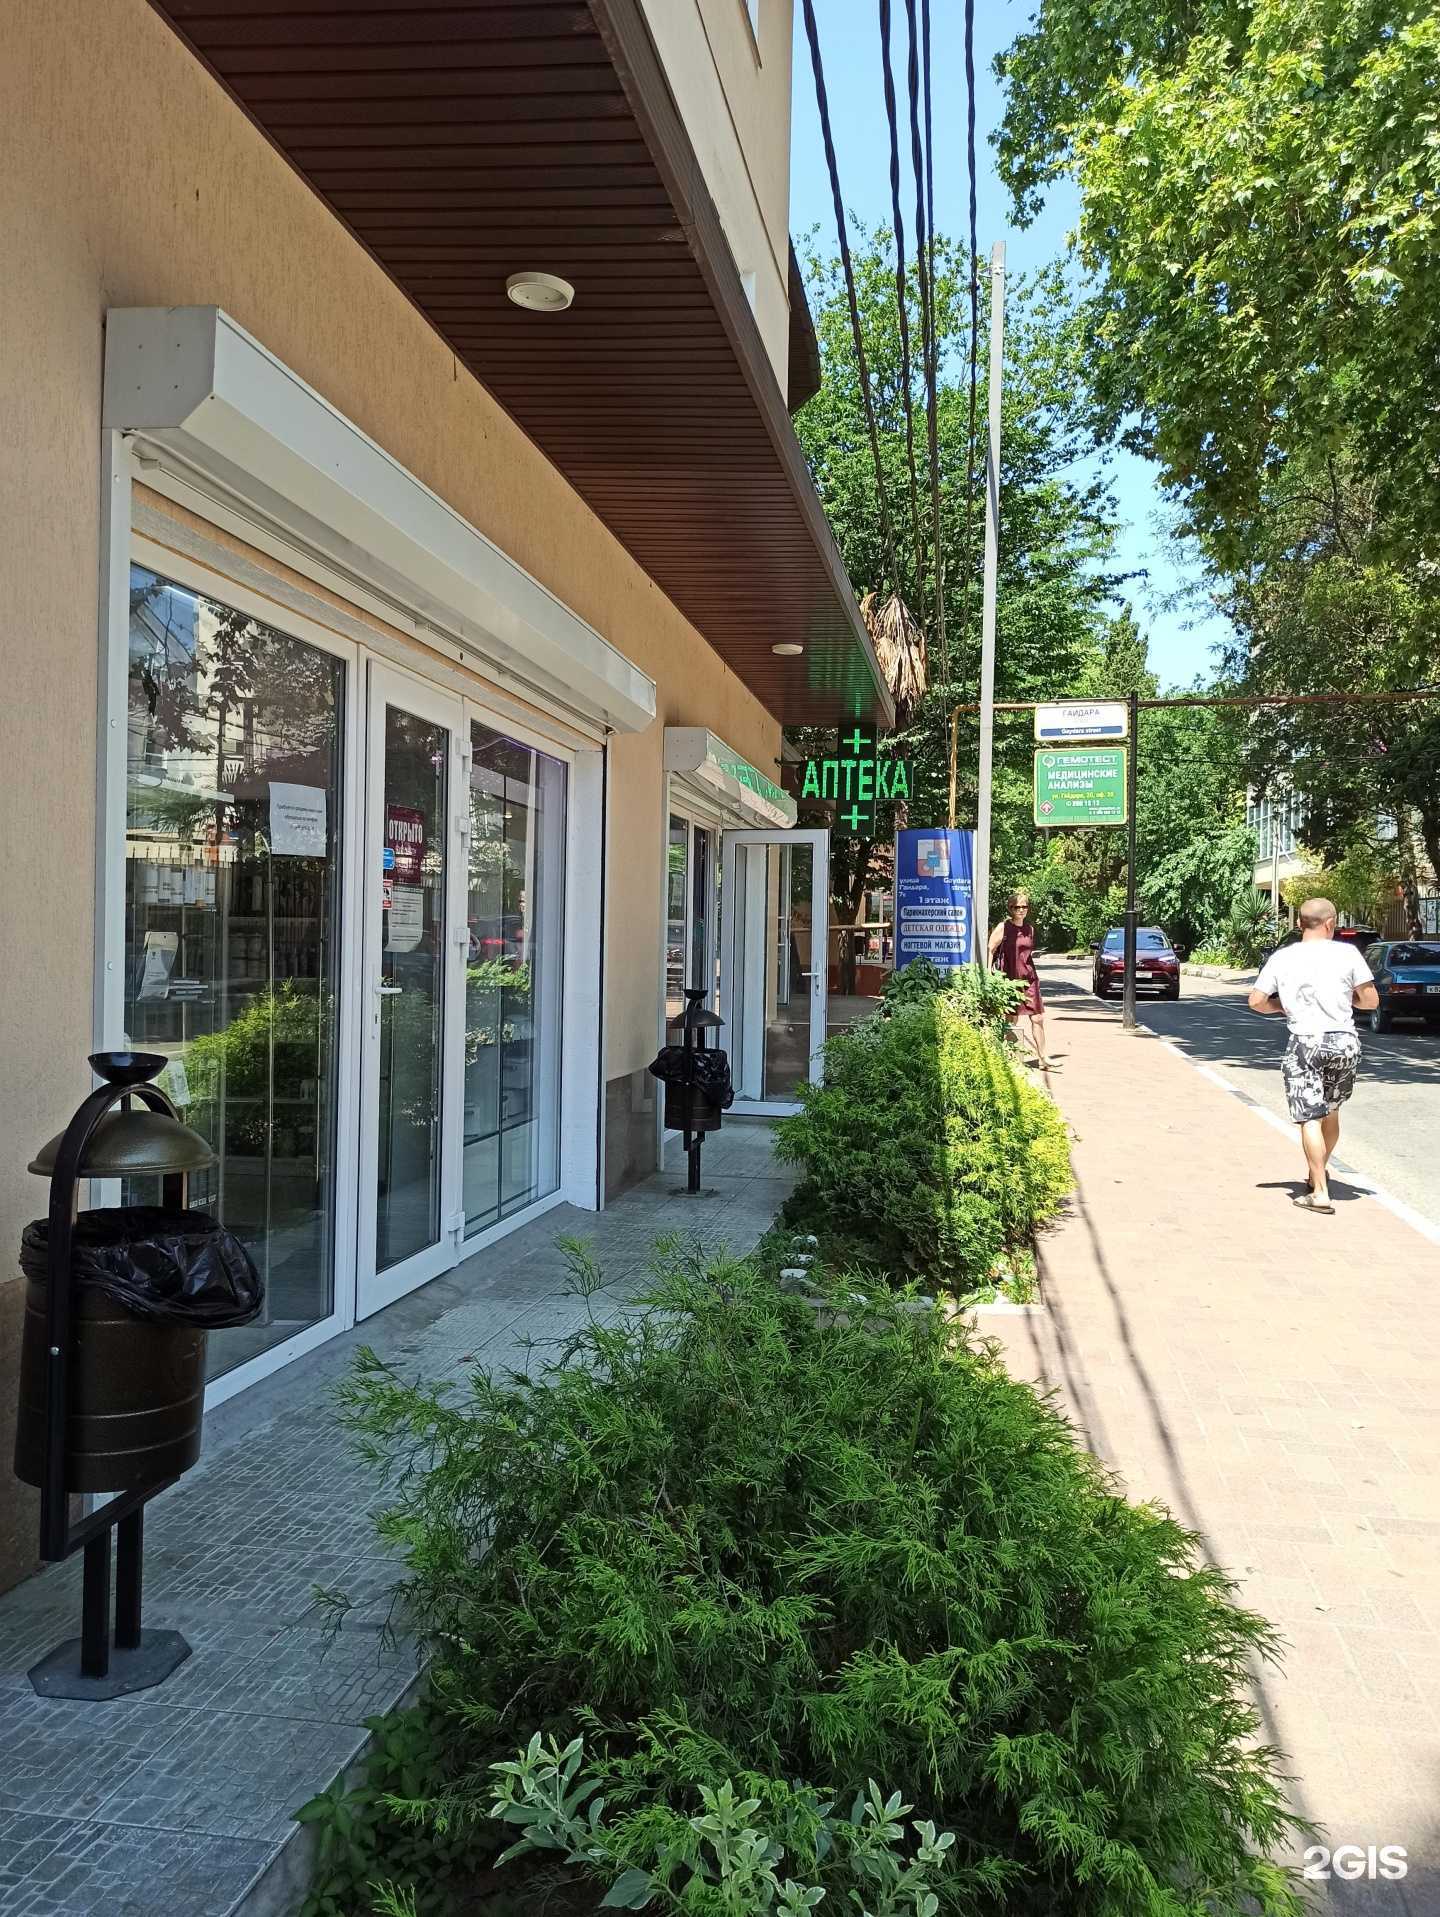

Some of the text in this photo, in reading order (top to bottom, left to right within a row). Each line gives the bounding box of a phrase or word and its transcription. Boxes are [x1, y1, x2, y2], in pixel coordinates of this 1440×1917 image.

[1047, 769, 1118, 780] МЕДИЦИНСКИЕ
[801, 760, 909, 800] АПТЕКА
[1047, 780, 1094, 790] АНАЛИЗЫ
[388, 819, 423, 844] ОТКРЫТО
[903, 924, 964, 933] ДЕТСКАЯ ОДЕЖДА
[903, 940, 932, 949] НОГТЕВОЙ
